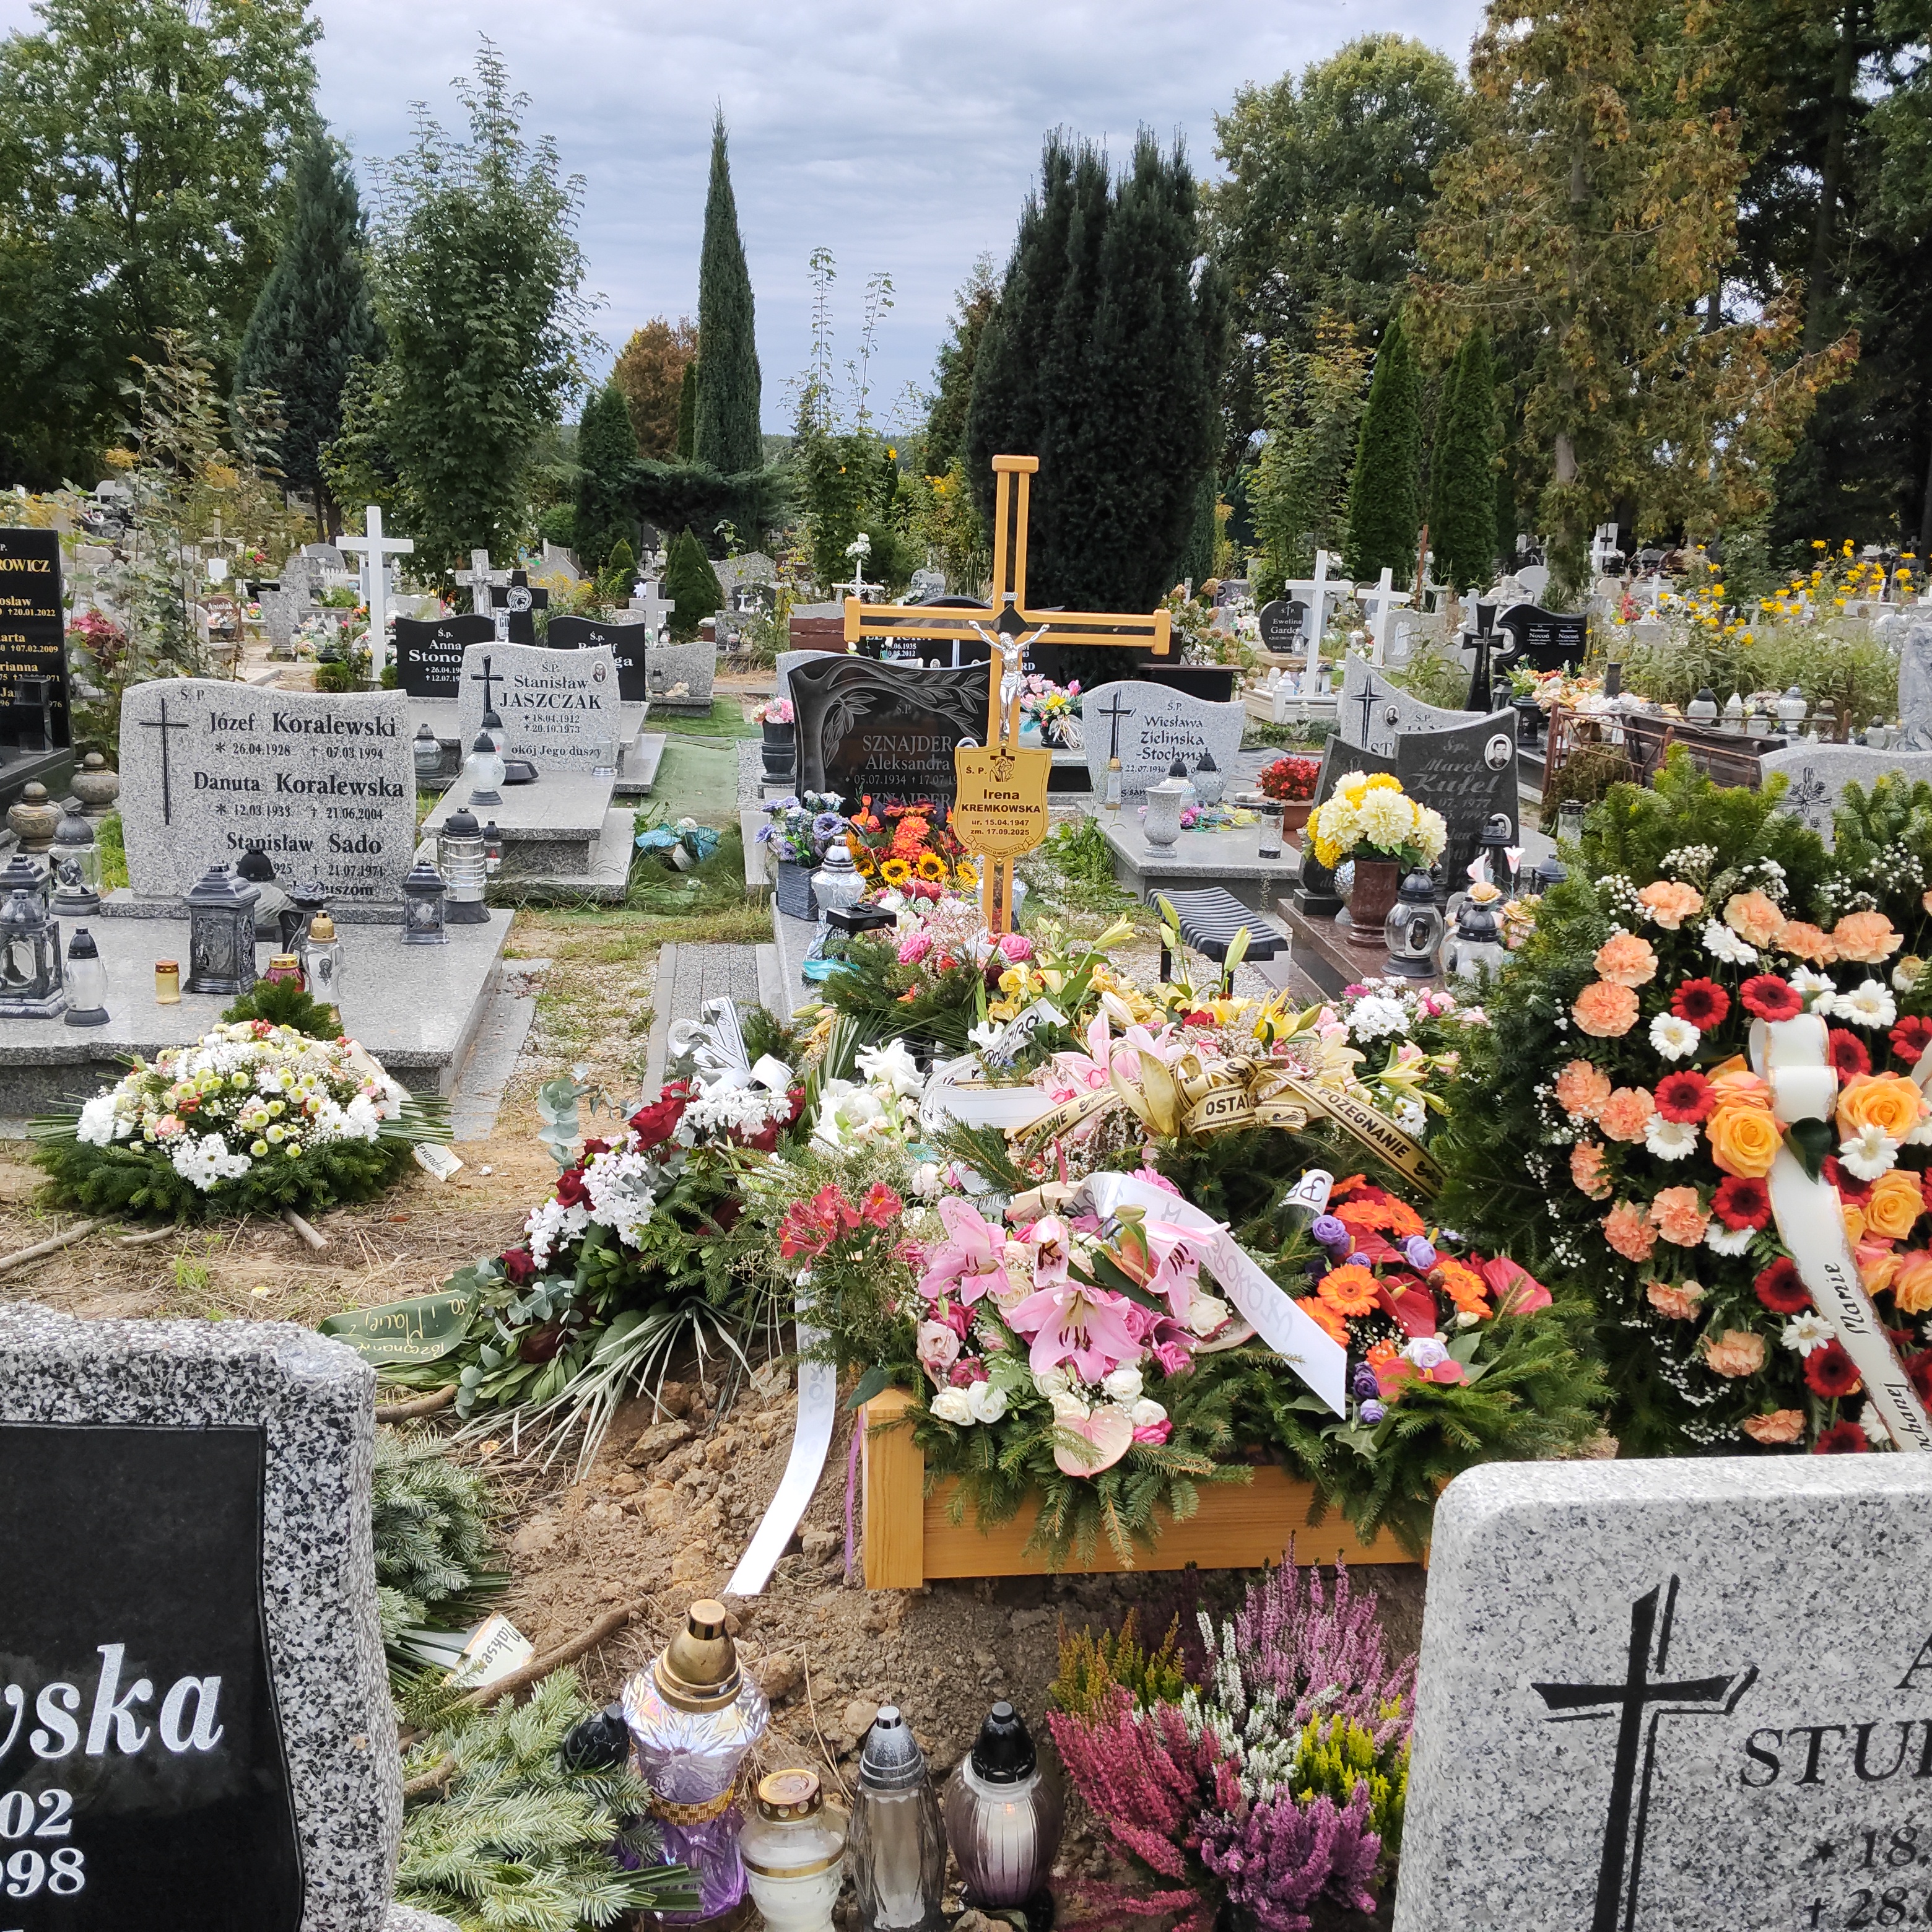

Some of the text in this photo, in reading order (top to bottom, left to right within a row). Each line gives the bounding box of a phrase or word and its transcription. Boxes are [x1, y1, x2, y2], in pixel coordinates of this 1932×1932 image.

[12, 609, 56, 617] 20.01.2022
[0, 633, 25, 643] arta
[438, 627, 453, 638] Ś.p.
[590, 631, 605, 642] Ś.p.
[15, 645, 59, 653] 07.02.2009
[429, 639, 462, 650] Anna
[409, 649, 462, 663] Stono
[514, 675, 588, 689] Stanisław
[499, 692, 602, 710] JASZCZAK
[209, 712, 396, 737] Józef Koralewski
[532, 714, 580, 723] 18.04.1912
[1144, 715, 1203, 728] Wiesława
[532, 724, 581, 734] 20.10.1973
[1140, 729, 1205, 746] Zielińska
[232, 743, 291, 757] 26.04.1928
[511, 745, 602, 759] okój Jego duszy
[862, 735, 954, 755] SZNAJDER
[864, 754, 951, 770] Aleksandra
[1419, 759, 1486, 773] Marek
[965, 765, 975, 774] Ś.
[193, 772, 404, 798] Danuta Koralewska
[854, 775, 957, 785] 05.07.1934 17.07.19
[1404, 774, 1500, 795] Kufel
[983, 789, 1020, 799] Irena
[326, 807, 384, 820] 21.06.2004
[961, 803, 1041, 813] KREMKOWSKA
[227, 832, 383, 854] Stanisław Sado
[1317, 1088, 1411, 1159] POŻEGNANIE
[1824, 1261, 1932, 1453] ochanej Mamie
[0, 1847, 86, 1897] 98
[1844, 1885, 1932, 1928] 28.
